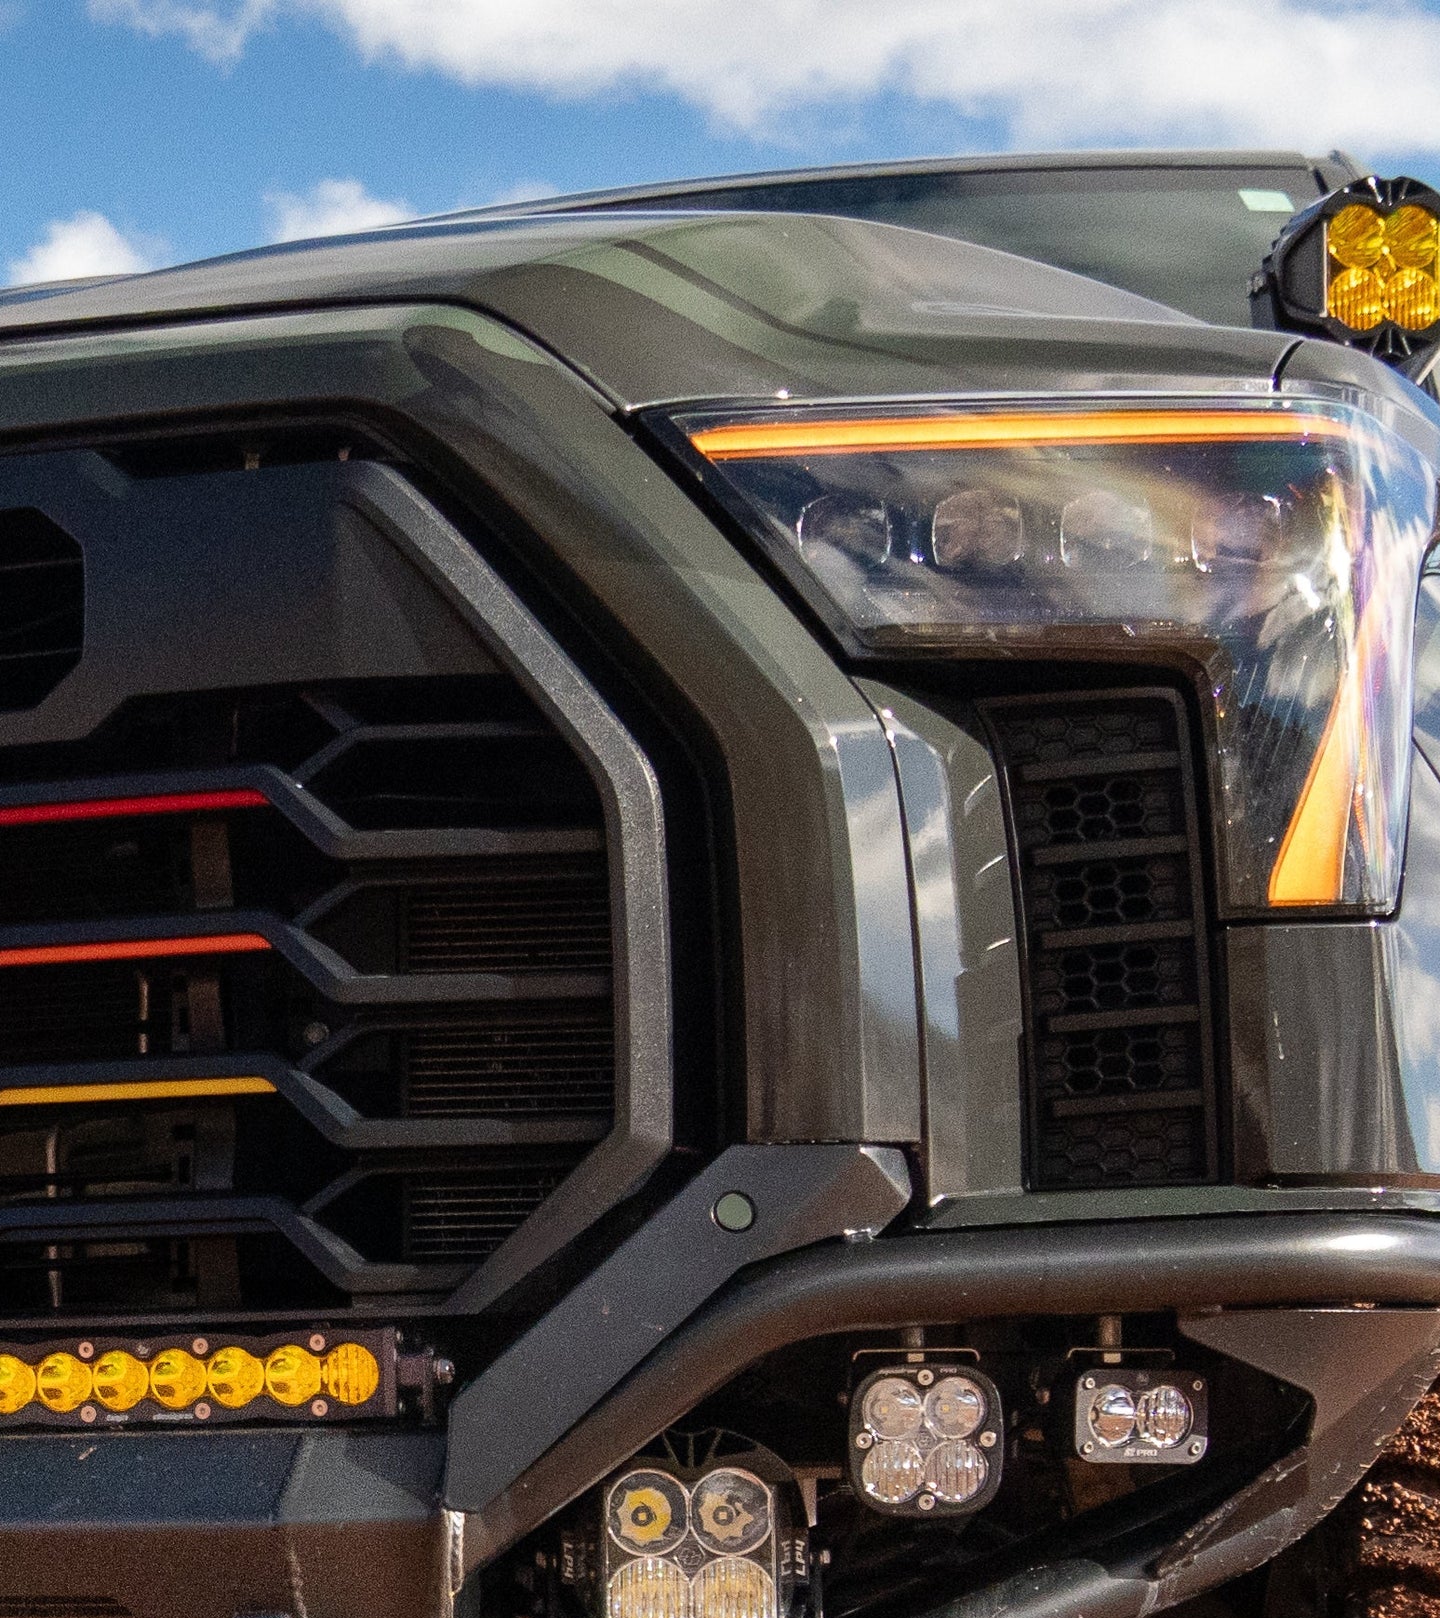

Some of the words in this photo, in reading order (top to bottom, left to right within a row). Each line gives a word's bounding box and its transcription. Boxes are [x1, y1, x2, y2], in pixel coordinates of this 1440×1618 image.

[1136, 1449, 1158, 1457] PRO
[563, 1542, 574, 1579] LP4
[795, 1540, 806, 1576] LP4
